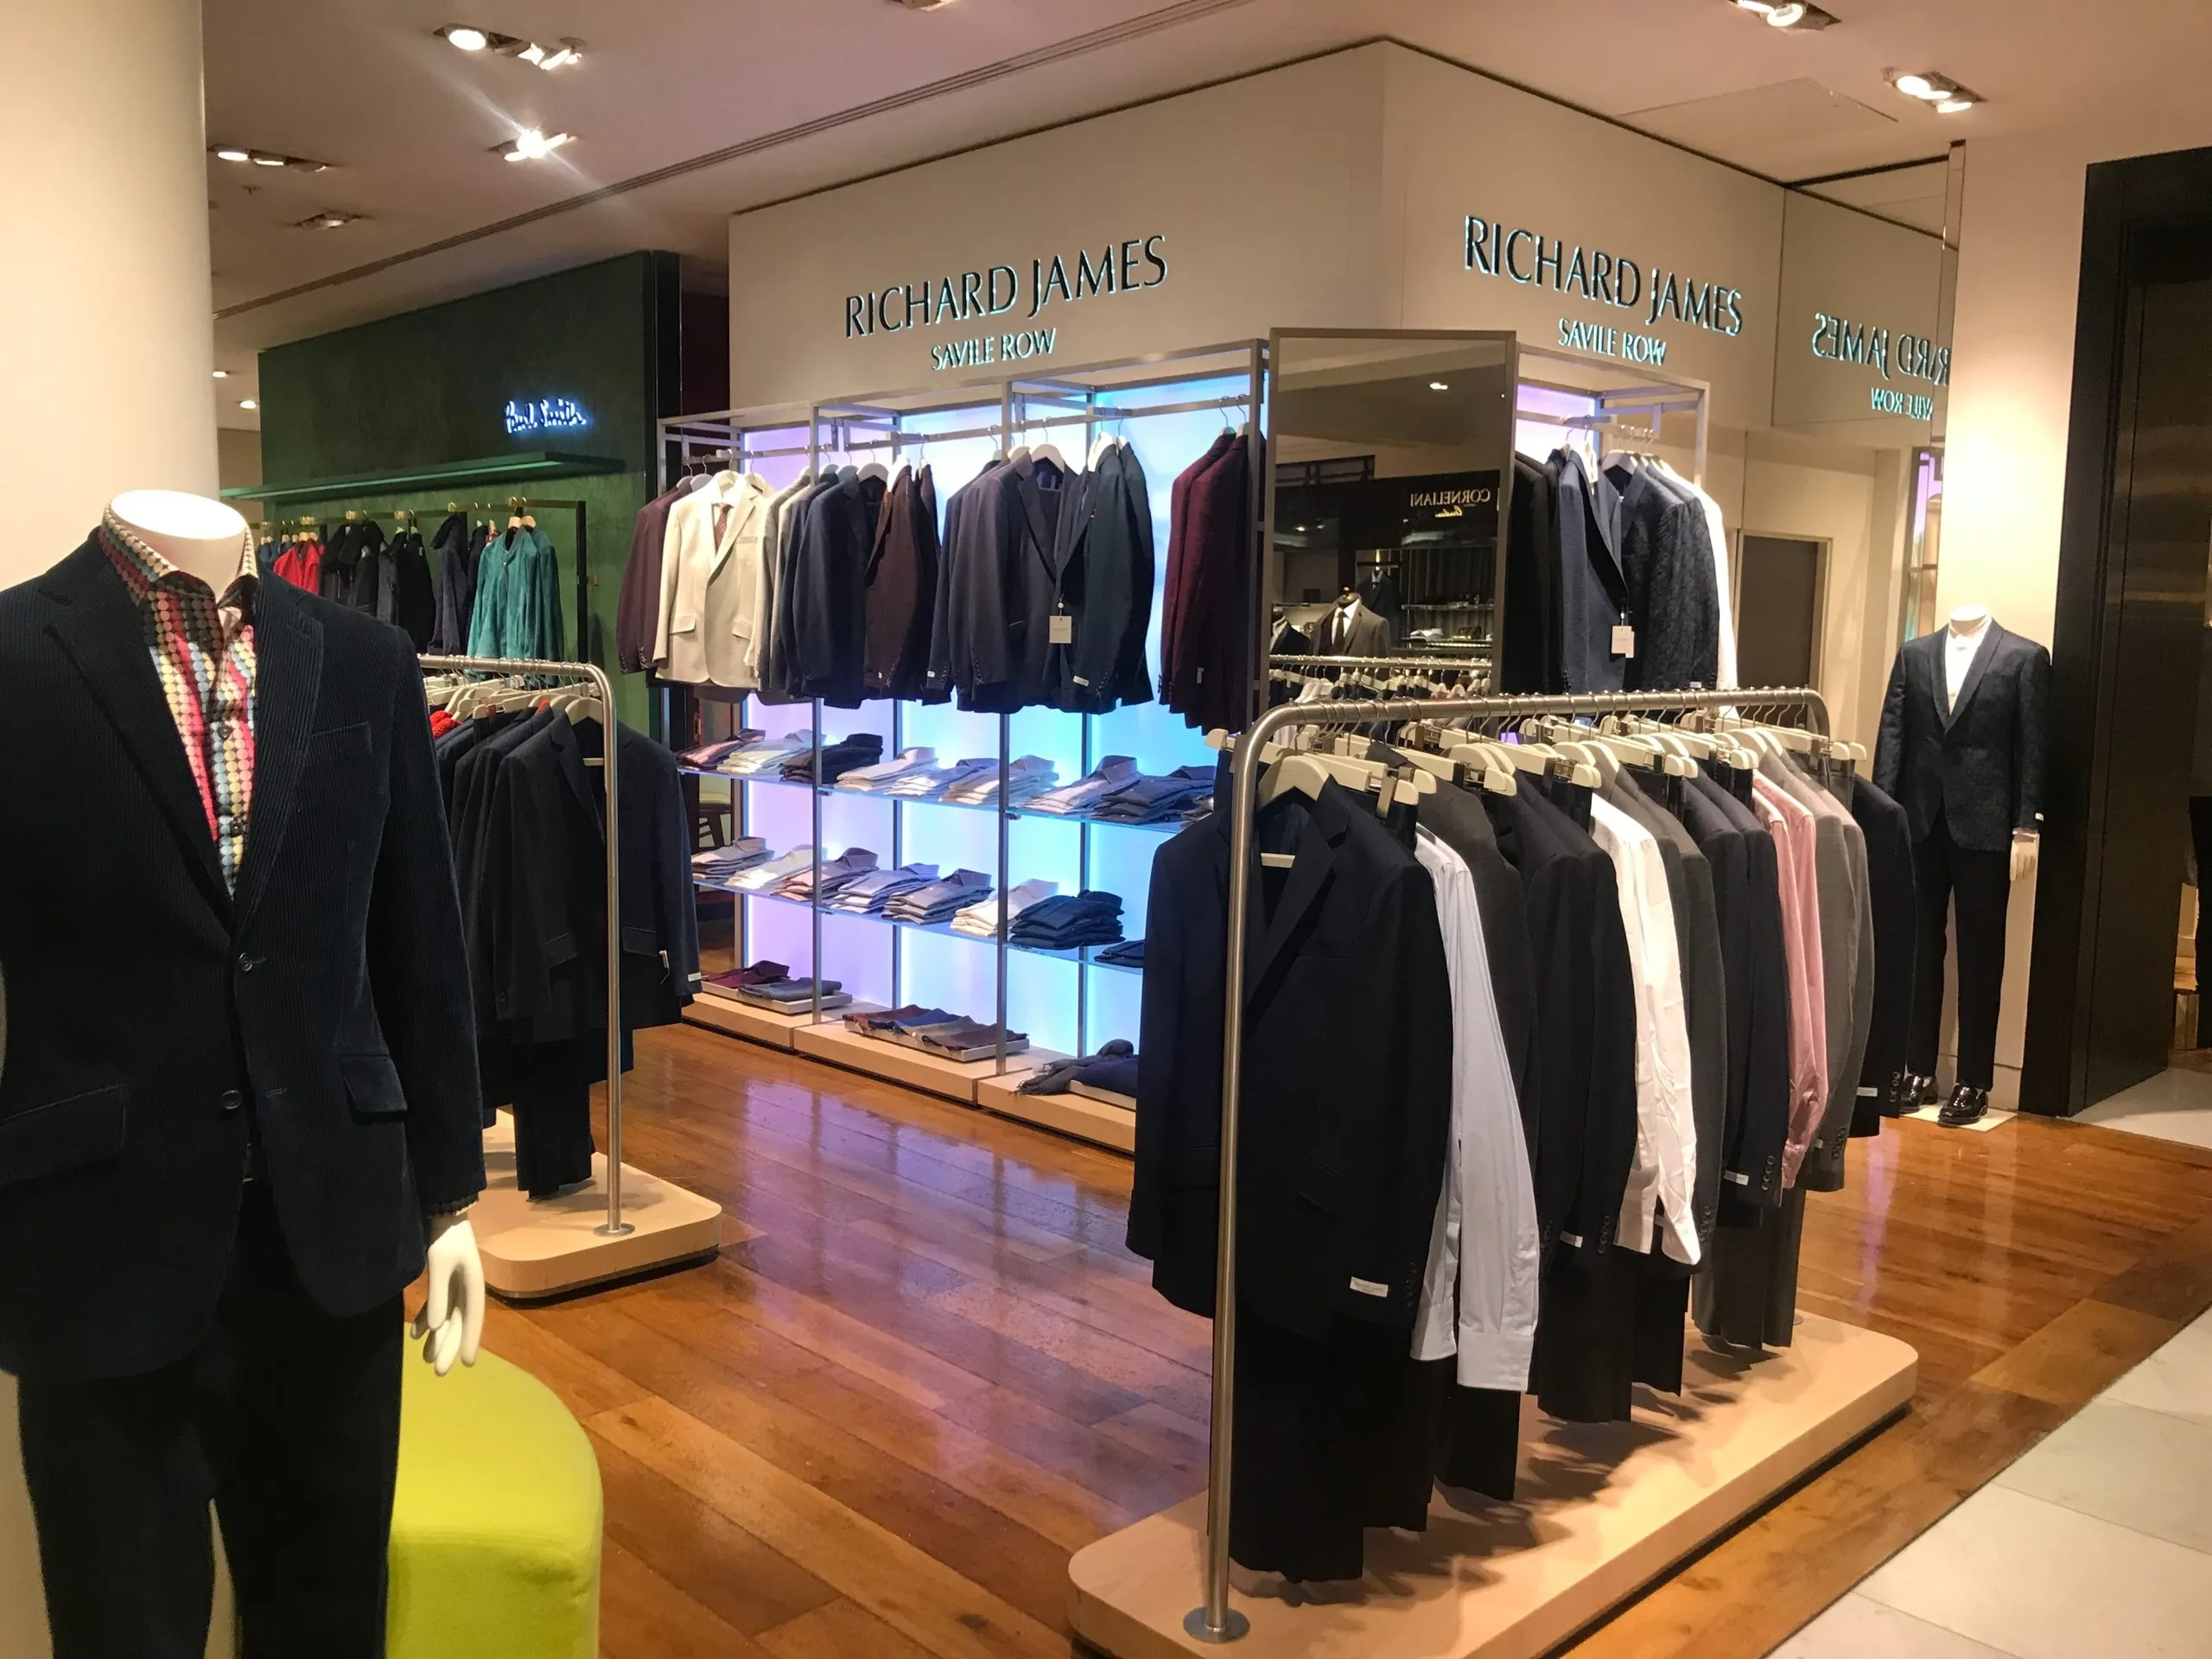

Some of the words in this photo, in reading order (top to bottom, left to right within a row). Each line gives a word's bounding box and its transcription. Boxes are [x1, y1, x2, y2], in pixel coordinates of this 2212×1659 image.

[845, 264, 1019, 339] RICHARD
[1027, 235, 1169, 318] JAMES
[1464, 214, 1641, 308] RICHARD
[1645, 268, 1743, 336] JAMES
[931, 335, 995, 371] SAVILE
[1001, 327, 1057, 360] ROW
[1558, 317, 1617, 357] SAVILE
[1622, 332, 1667, 366] ROW
